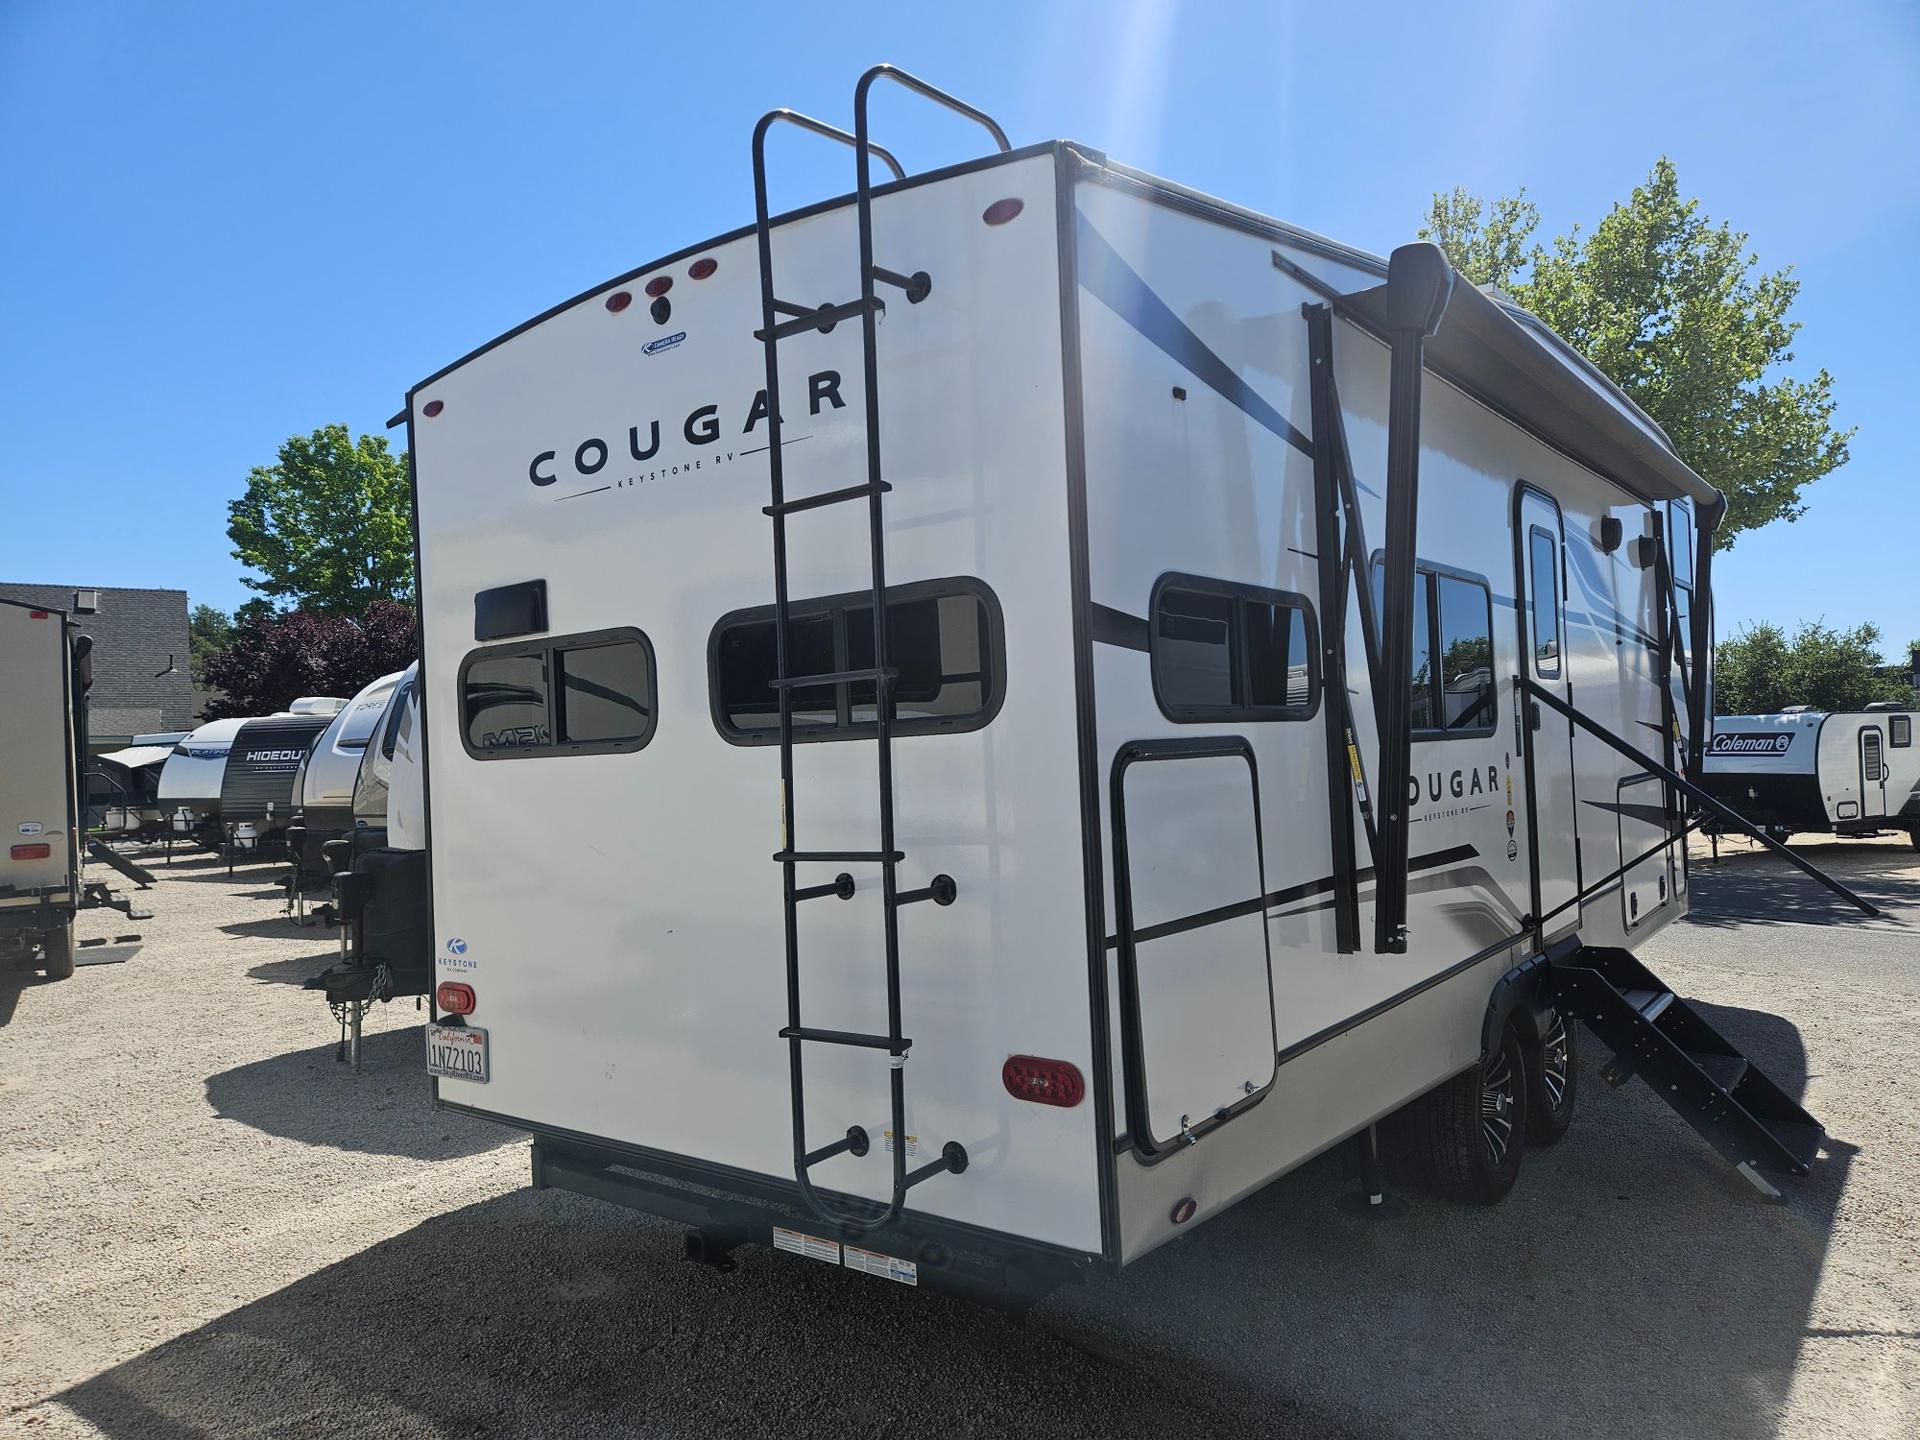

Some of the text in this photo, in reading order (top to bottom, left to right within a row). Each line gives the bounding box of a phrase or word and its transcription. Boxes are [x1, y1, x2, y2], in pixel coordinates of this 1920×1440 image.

[529, 370, 847, 487] COUGAR
[618, 452, 734, 488] KEYSTONE RV
[1713, 734, 1774, 751] Coleman
[1408, 765, 1499, 806] OUGAR
[438, 957, 478, 969] KEYSTONE
[432, 1044, 481, 1074] 1NZ2103
